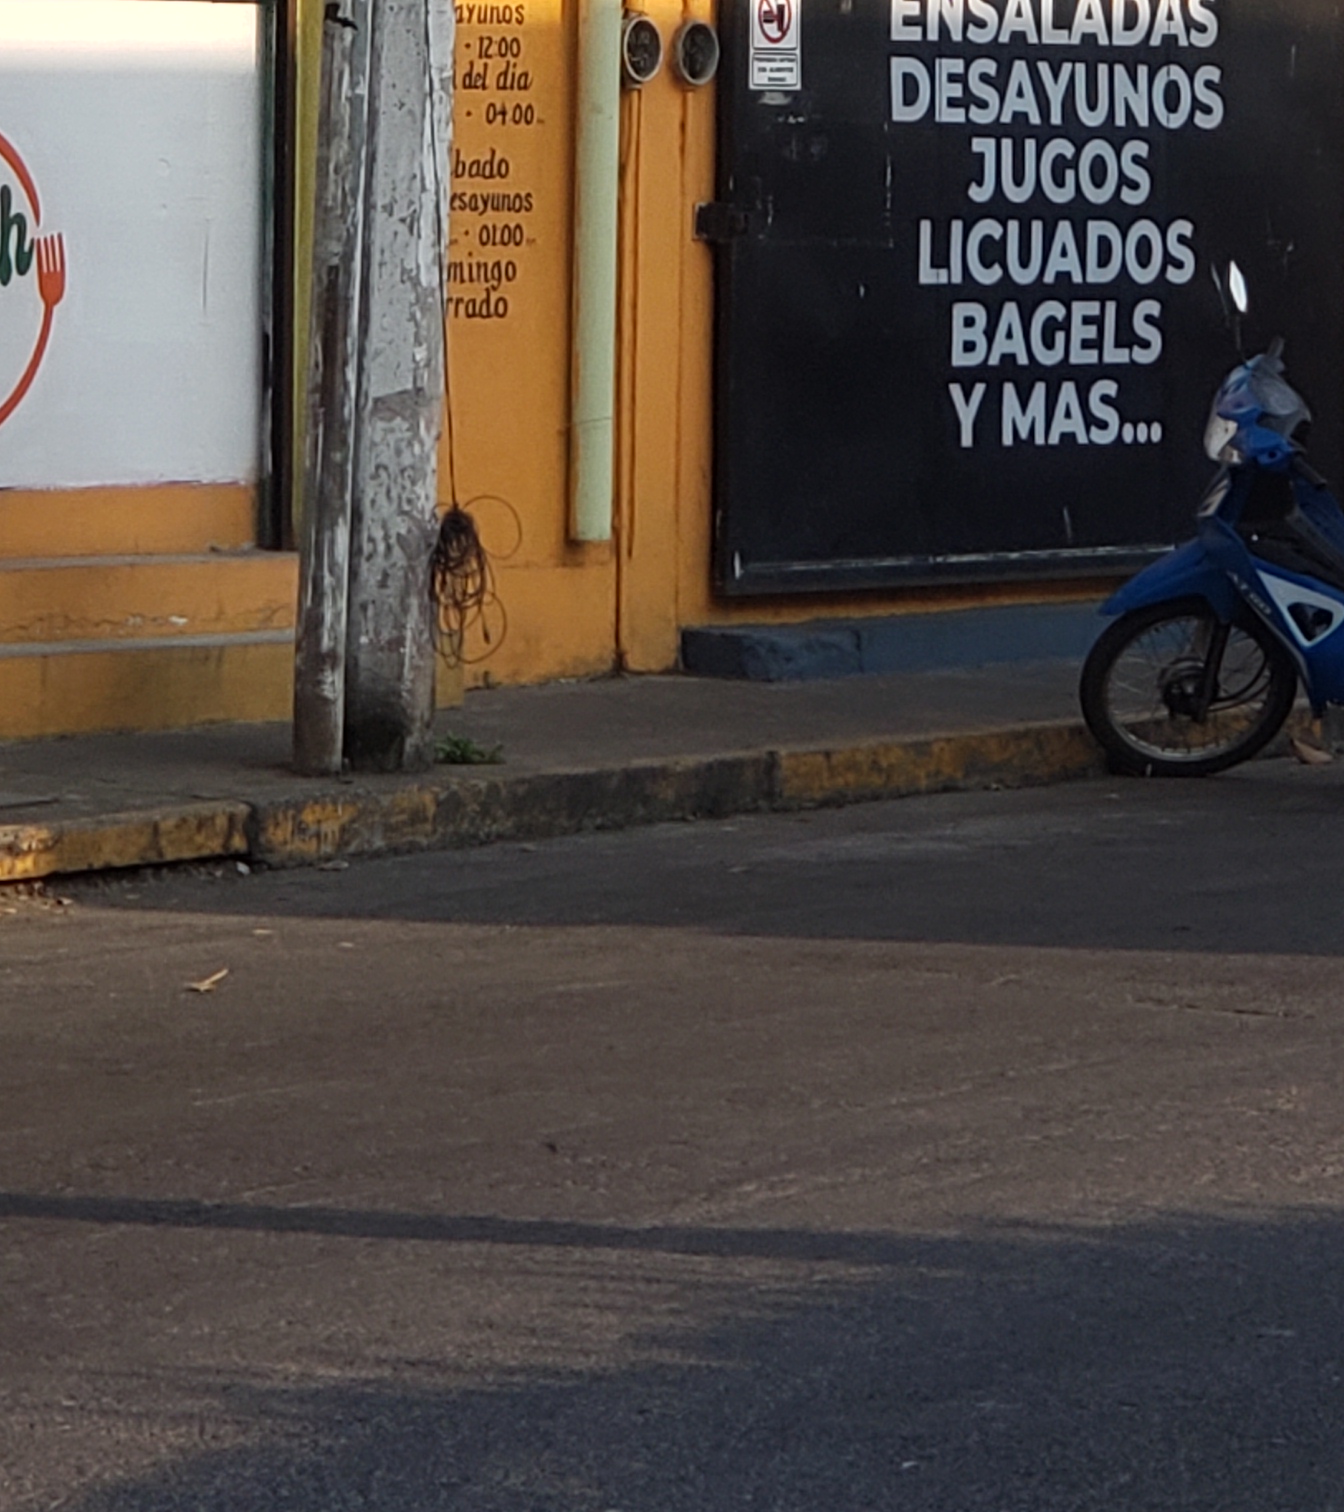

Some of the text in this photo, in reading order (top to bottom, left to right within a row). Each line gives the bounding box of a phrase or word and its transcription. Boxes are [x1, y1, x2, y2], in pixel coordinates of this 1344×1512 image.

[462, 60, 488, 90] del
[890, 56, 1224, 129] DESAYUNOS
[449, 192, 533, 216] esayunos
[968, 137, 1151, 204] JUGOS
[918, 219, 1196, 285] LICUADOS
[950, 299, 1162, 367] BAGELS
[948, 380, 1162, 447] Y MAS...
